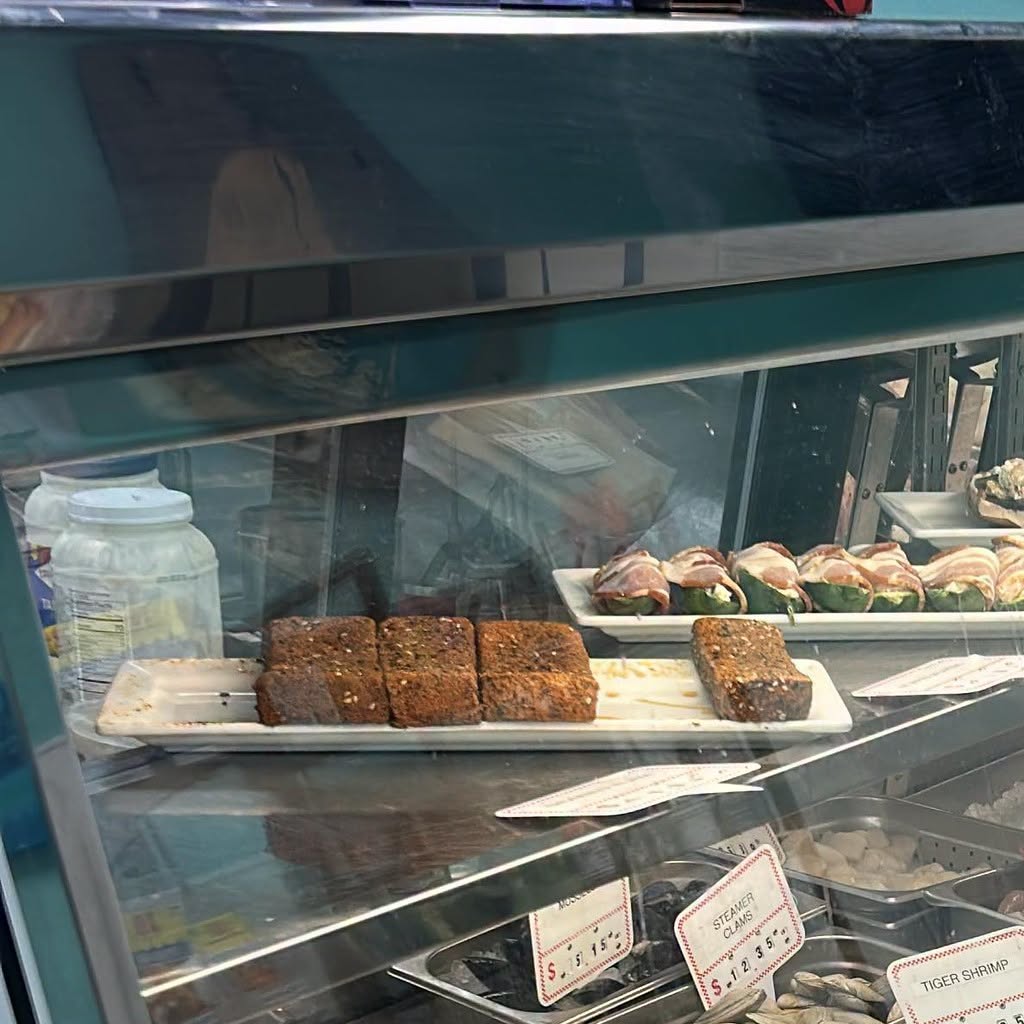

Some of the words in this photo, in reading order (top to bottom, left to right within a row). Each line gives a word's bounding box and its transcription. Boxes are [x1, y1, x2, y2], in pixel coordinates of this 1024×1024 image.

[713, 892, 755, 930] STEAMER
[723, 911, 754, 939] CLAMS
[920, 973, 960, 993] TIGER
[962, 959, 1010, 982] SHRIMP
